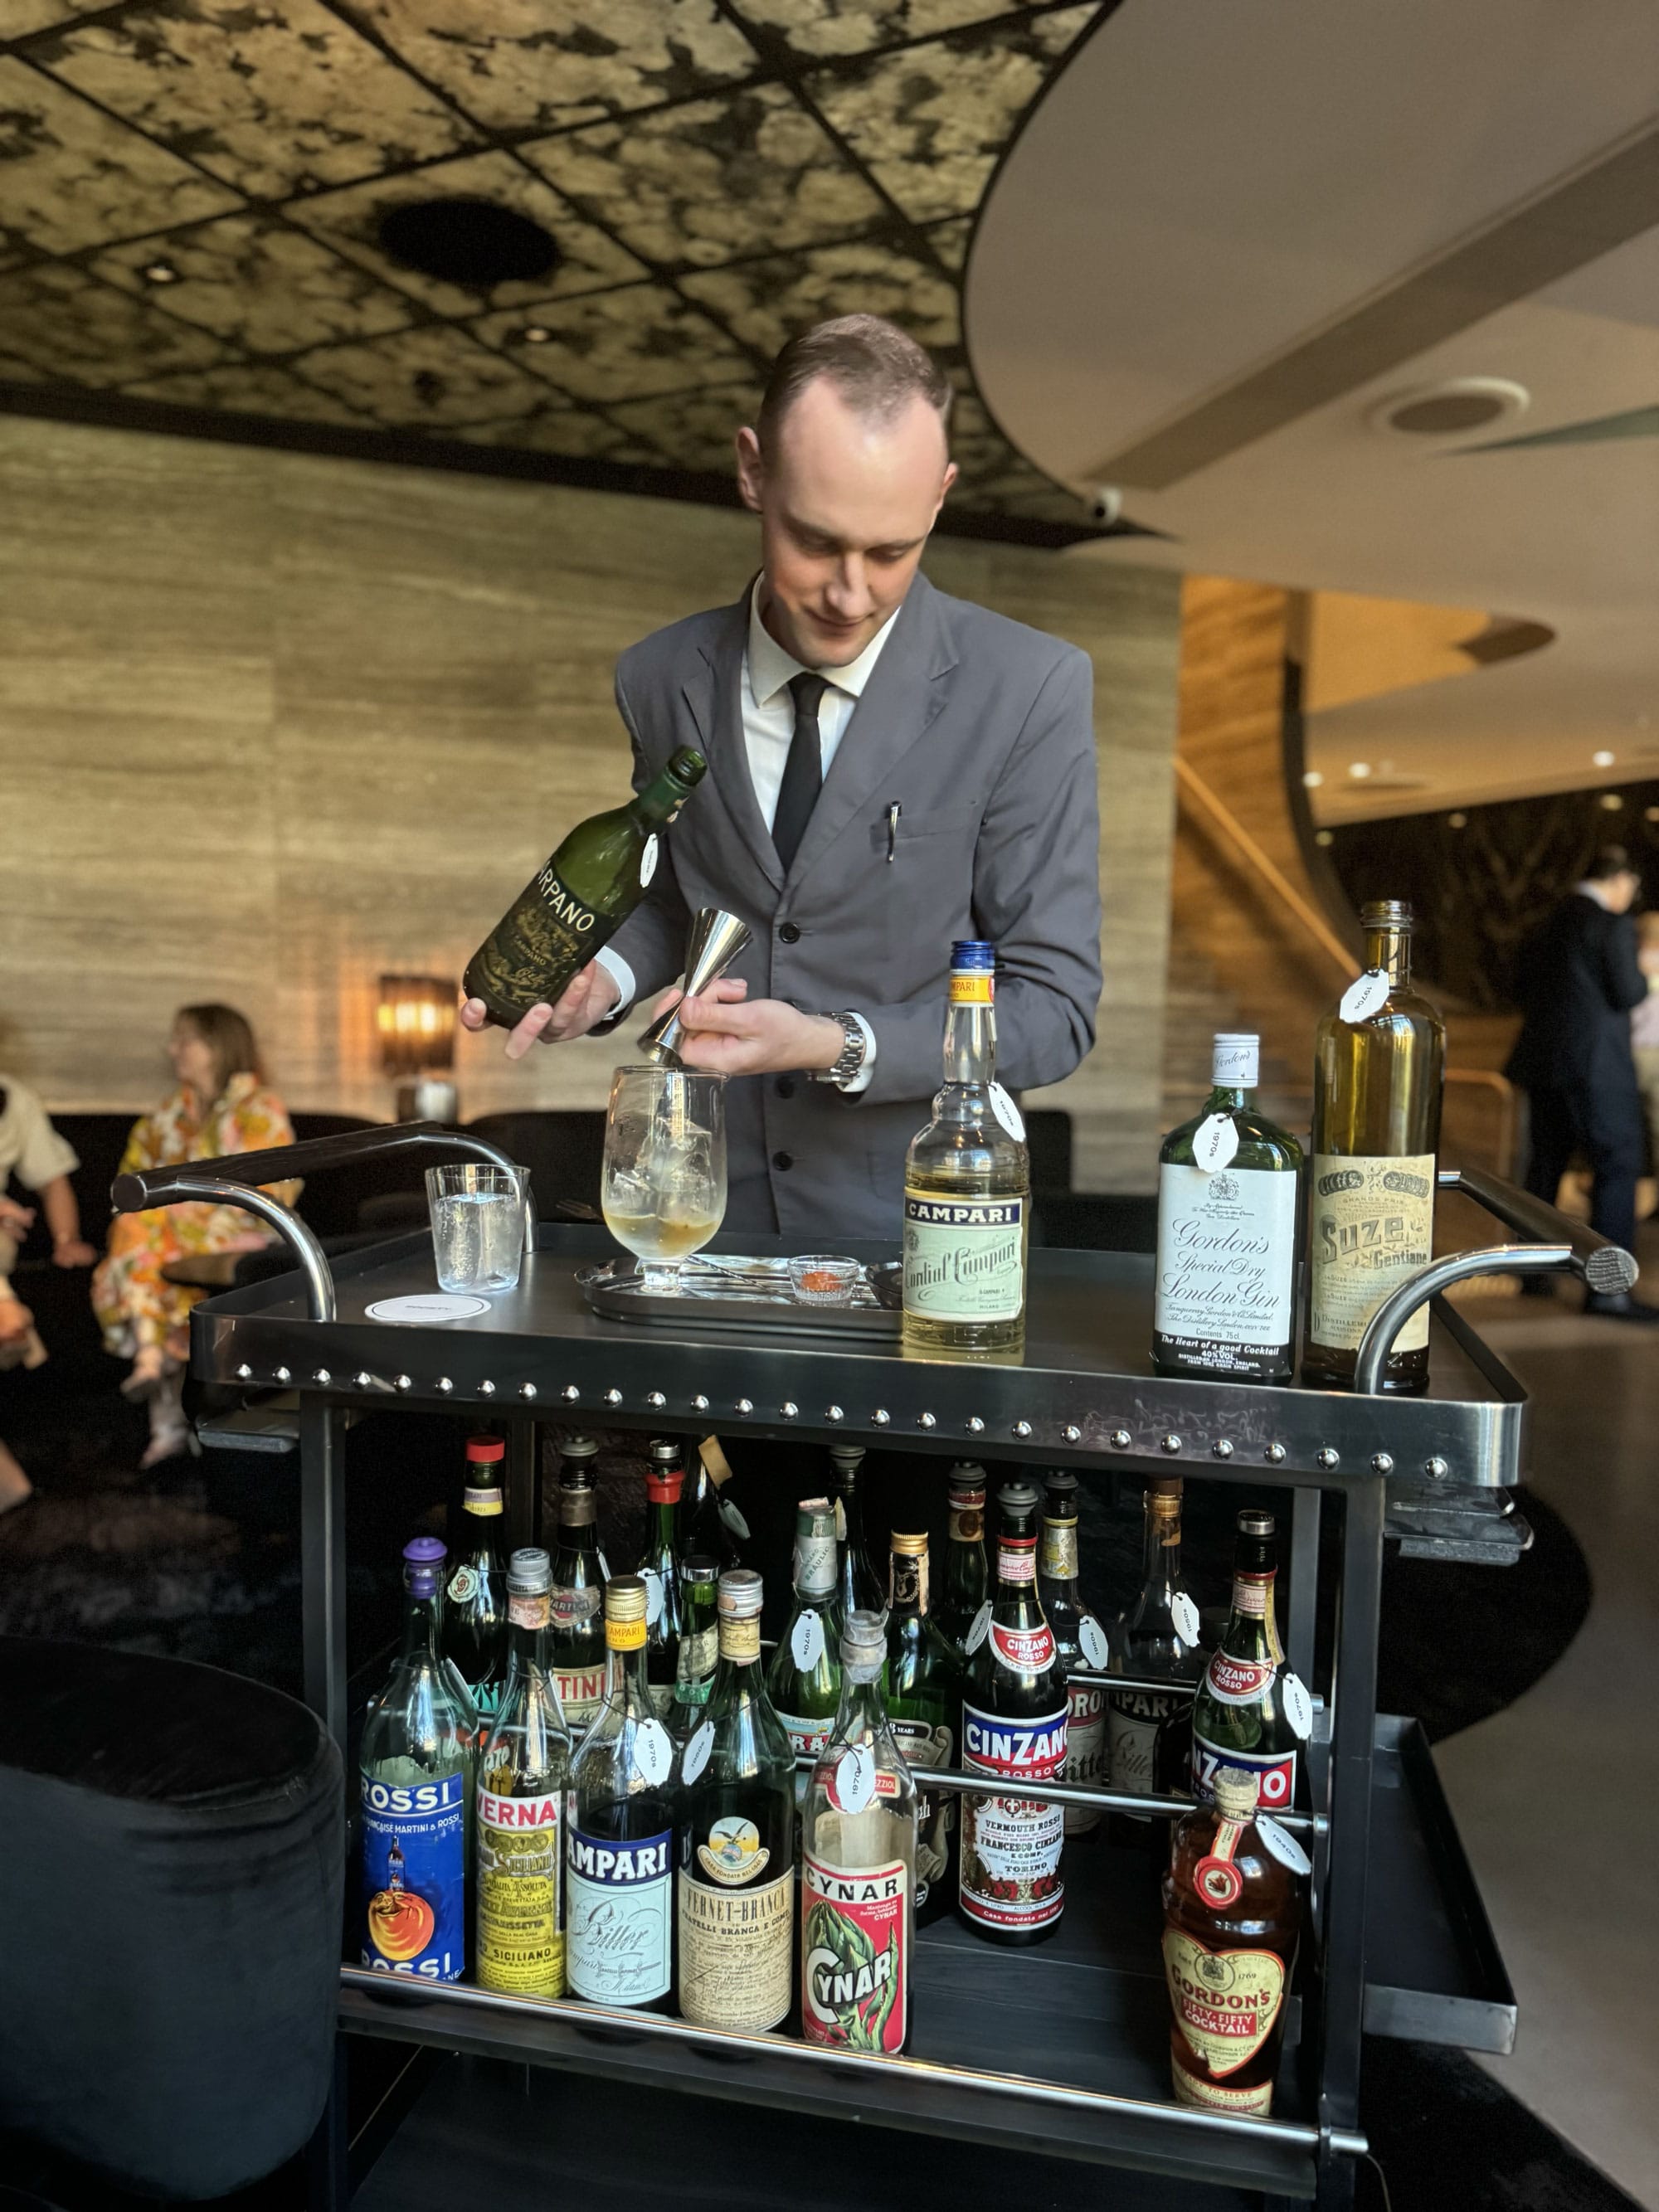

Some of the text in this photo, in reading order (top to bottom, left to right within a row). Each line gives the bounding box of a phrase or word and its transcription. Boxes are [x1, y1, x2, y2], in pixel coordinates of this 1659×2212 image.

[1209, 1131, 1220, 1158] 1970s
[909, 1203, 1012, 1223] CAMPARI
[1173, 1218, 1270, 1255] Gordon's
[1175, 1251, 1266, 1284] Special Dry
[1161, 1272, 1282, 1309] London Gin
[1196, 1329, 1223, 1338] Contents
[1161, 1334, 1174, 1344] The
[1175, 1335, 1199, 1347] Heart
[1219, 1344, 1242, 1354] good
[1244, 1345, 1280, 1356] Cocktail
[1007, 1636, 1048, 1652] CINZANO
[1018, 1650, 1044, 1660] ROSSO
[1214, 1659, 1255, 1683] CINZANO
[557, 1672, 606, 1699] TINI
[1216, 1675, 1243, 1689] ROSSO
[875, 1778, 895, 1789] ZZIOL
[362, 1777, 450, 1813] ROSSI
[395, 1824, 429, 1833] MARTINI
[438, 1814, 460, 1829] ROSSI
[985, 1815, 1061, 1833] VERMOUTH ROSSO
[980, 1836, 1033, 1852] FRANCESCO
[1005, 1862, 1048, 1873] TORINO
[806, 1867, 898, 1901] CYNAR
[874, 1909, 898, 1921] CYNAR
[984, 1911, 1003, 1921] Casa
[1005, 1912, 1036, 1923] fondata
[721, 1925, 760, 1936] BRANCA
[494, 1947, 552, 1962] SICILIANO
[807, 1947, 891, 2024] CYNAR
[1171, 1963, 1271, 2010] GORDON'S
[1185, 2011, 1249, 2035] COCKTAIL
